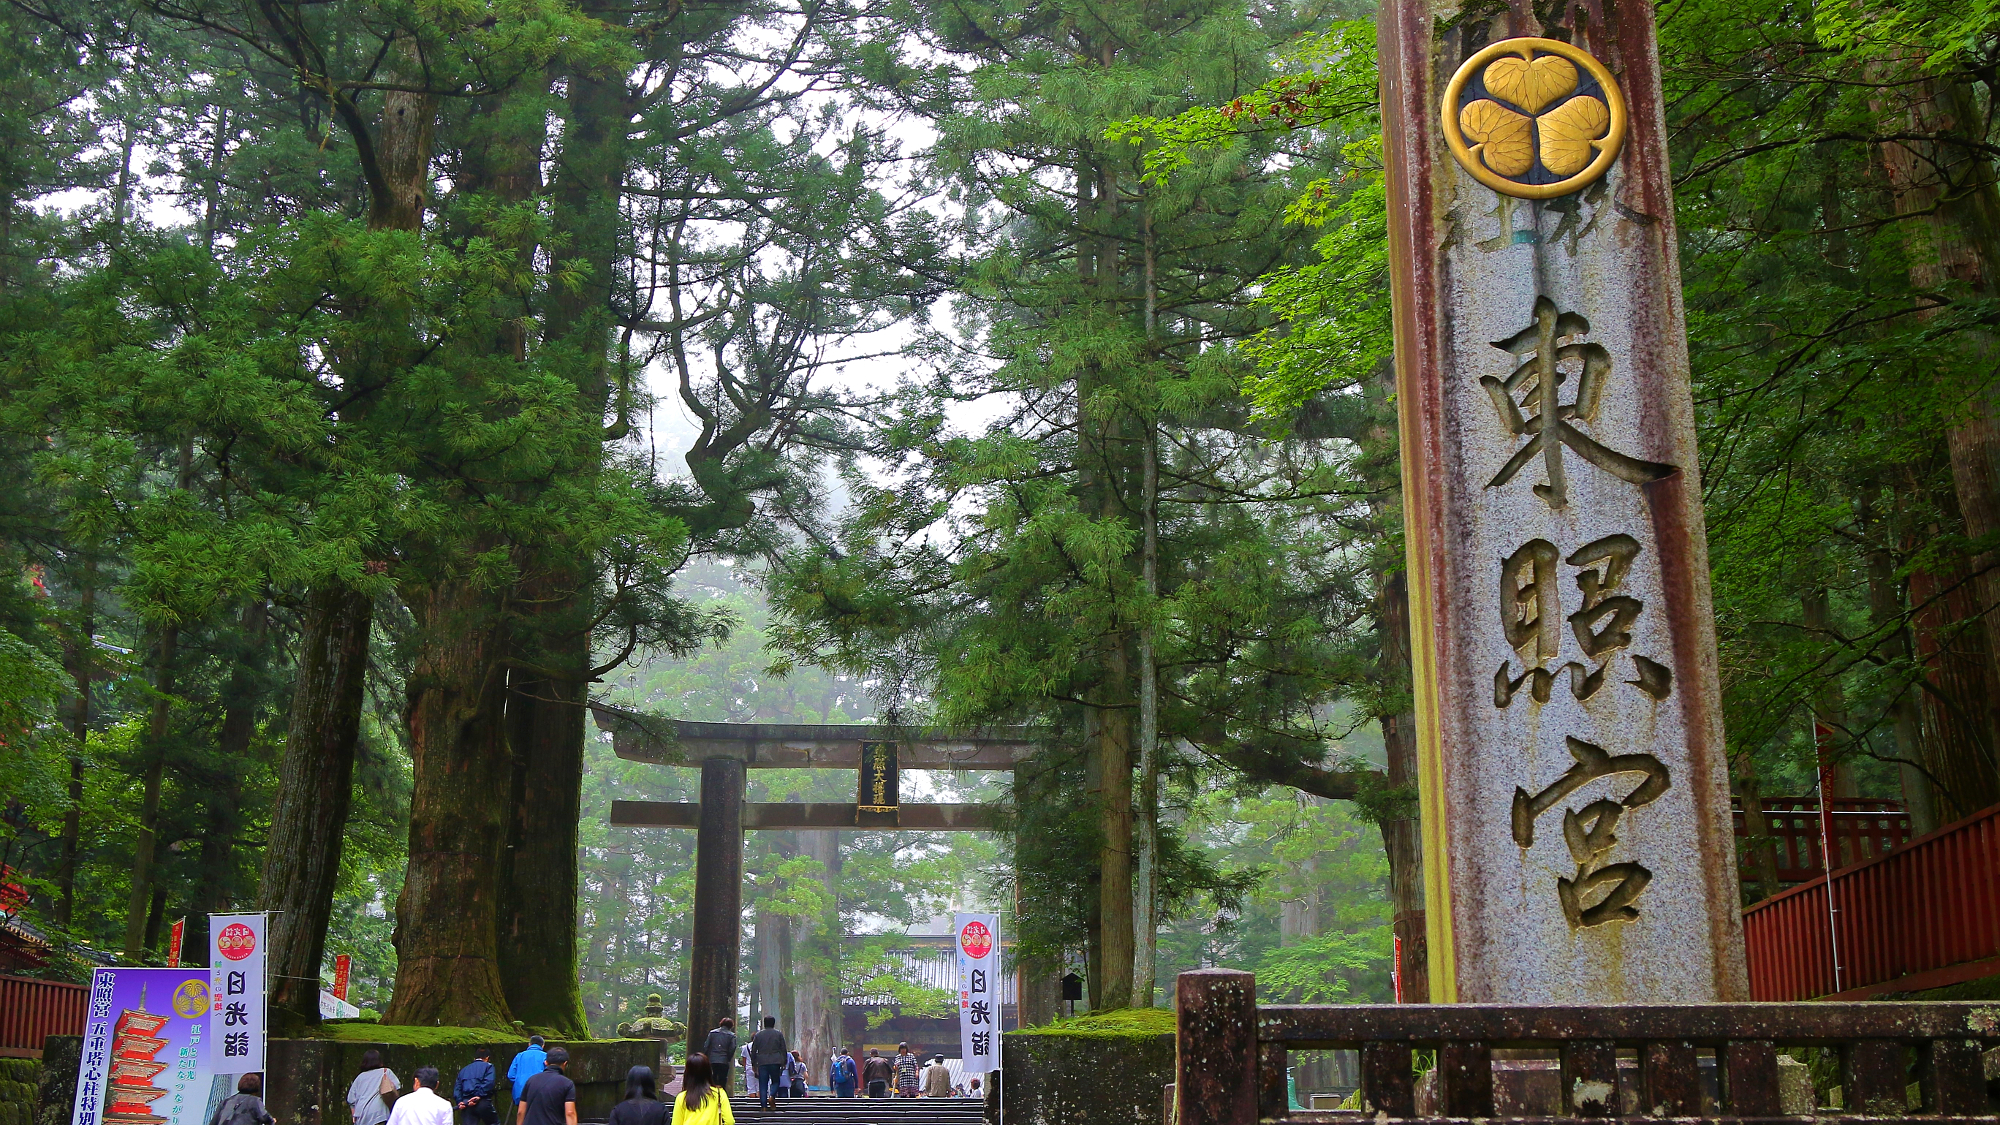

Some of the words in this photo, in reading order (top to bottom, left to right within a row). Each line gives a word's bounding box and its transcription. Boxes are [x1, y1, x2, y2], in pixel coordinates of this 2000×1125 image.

[1480, 295, 1684, 930] 東照宮
[94, 972, 115, 1018] 東照宮
[186, 1024, 202, 1081] 江戸と日光
